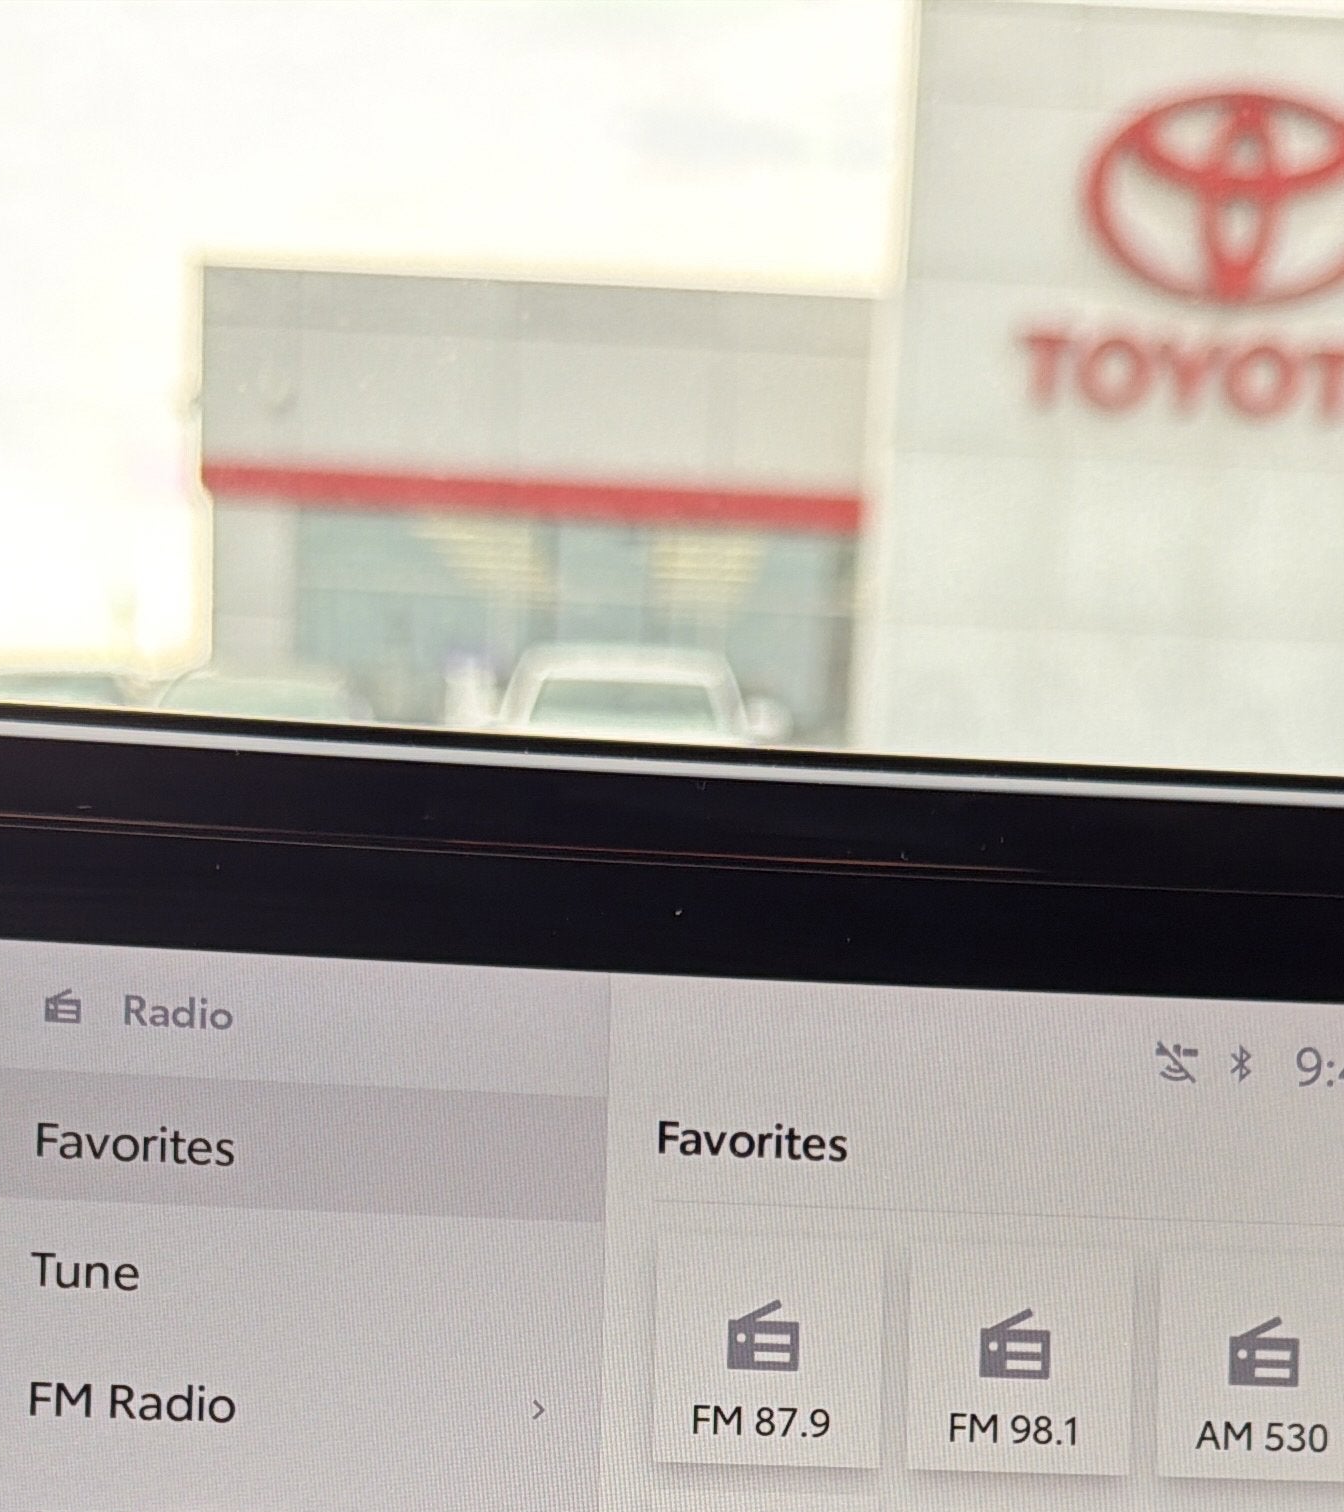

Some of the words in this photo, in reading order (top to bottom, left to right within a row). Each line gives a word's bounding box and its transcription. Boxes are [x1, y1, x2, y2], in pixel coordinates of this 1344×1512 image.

[122, 993, 234, 1032] Radio
[35, 1122, 236, 1167] Favorites
[656, 1121, 849, 1164] Favorites
[31, 1251, 141, 1292] Tune
[29, 1381, 93, 1420] FM
[108, 1383, 236, 1424] Radio
[691, 1405, 743, 1438] FM
[754, 1407, 831, 1440] 87.9
[948, 1412, 999, 1445] FM
[1009, 1415, 1080, 1448] 98.1
[1195, 1420, 1255, 1452] AM
[1264, 1422, 1330, 1455] 530
